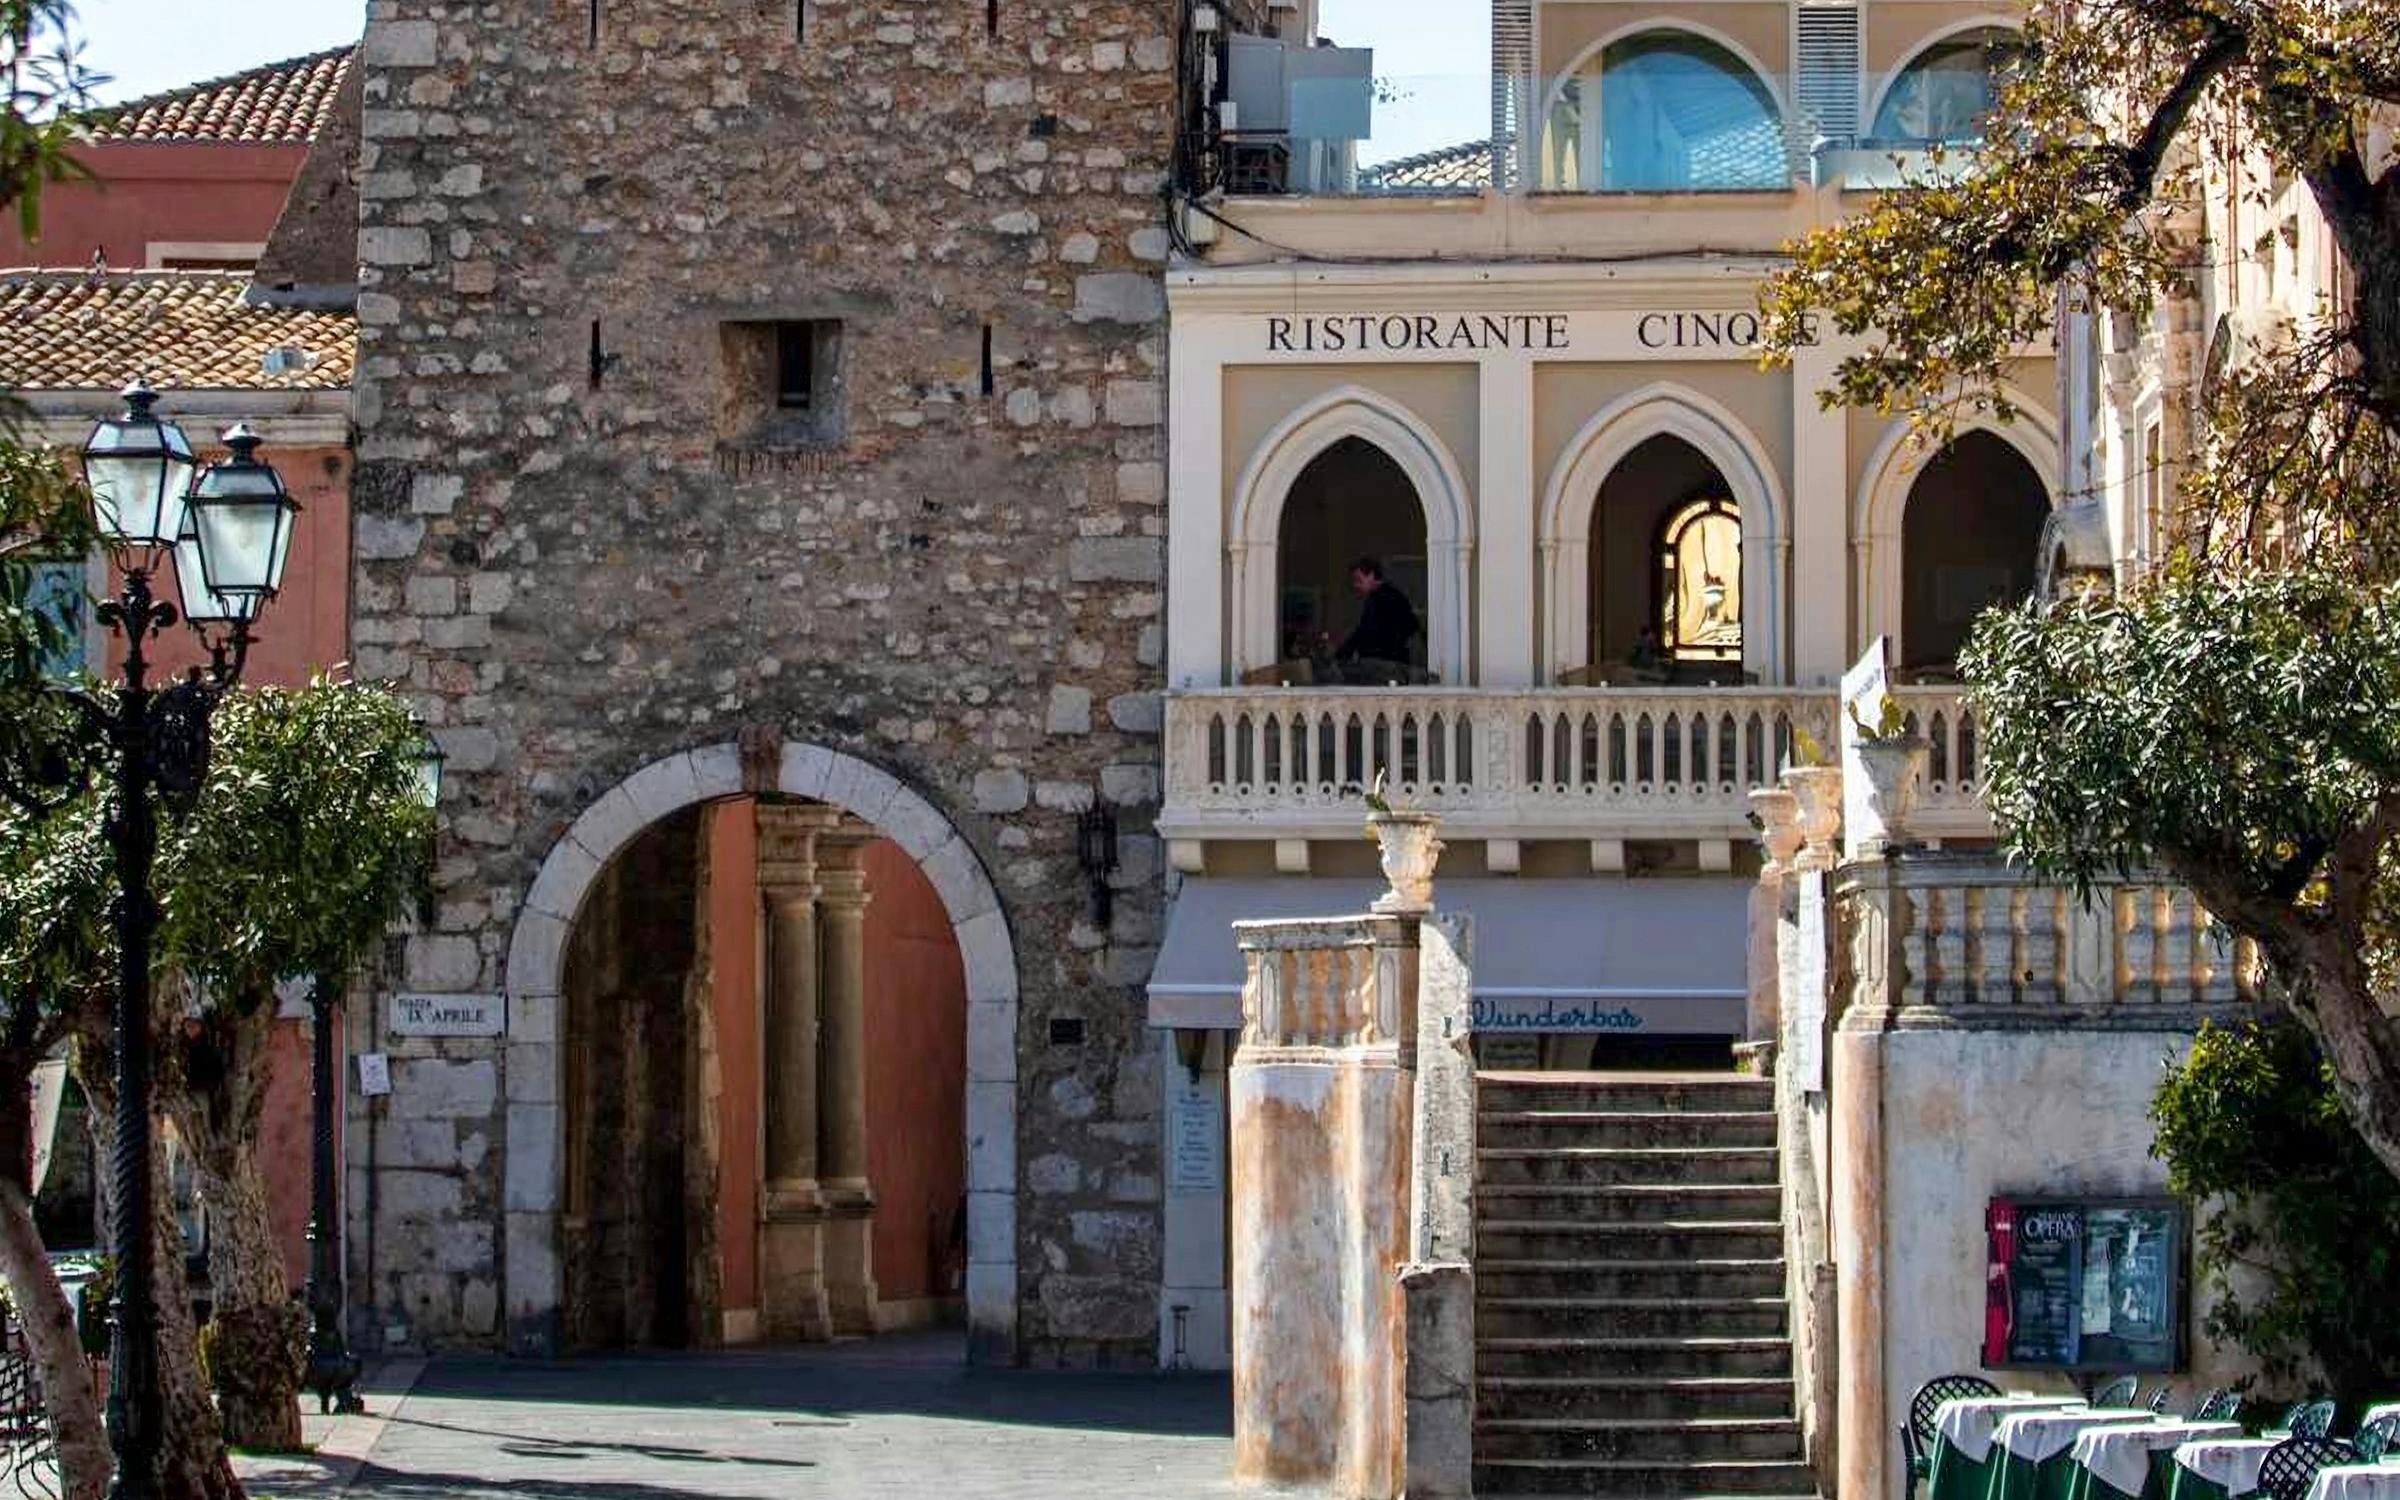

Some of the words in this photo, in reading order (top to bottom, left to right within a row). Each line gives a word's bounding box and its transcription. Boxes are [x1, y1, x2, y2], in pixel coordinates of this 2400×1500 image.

[1266, 314, 1570, 351] RISTORANTE
[1638, 312, 1822, 348] CINQE
[408, 1008, 423, 1024] IX
[431, 1007, 486, 1024] APRILE
